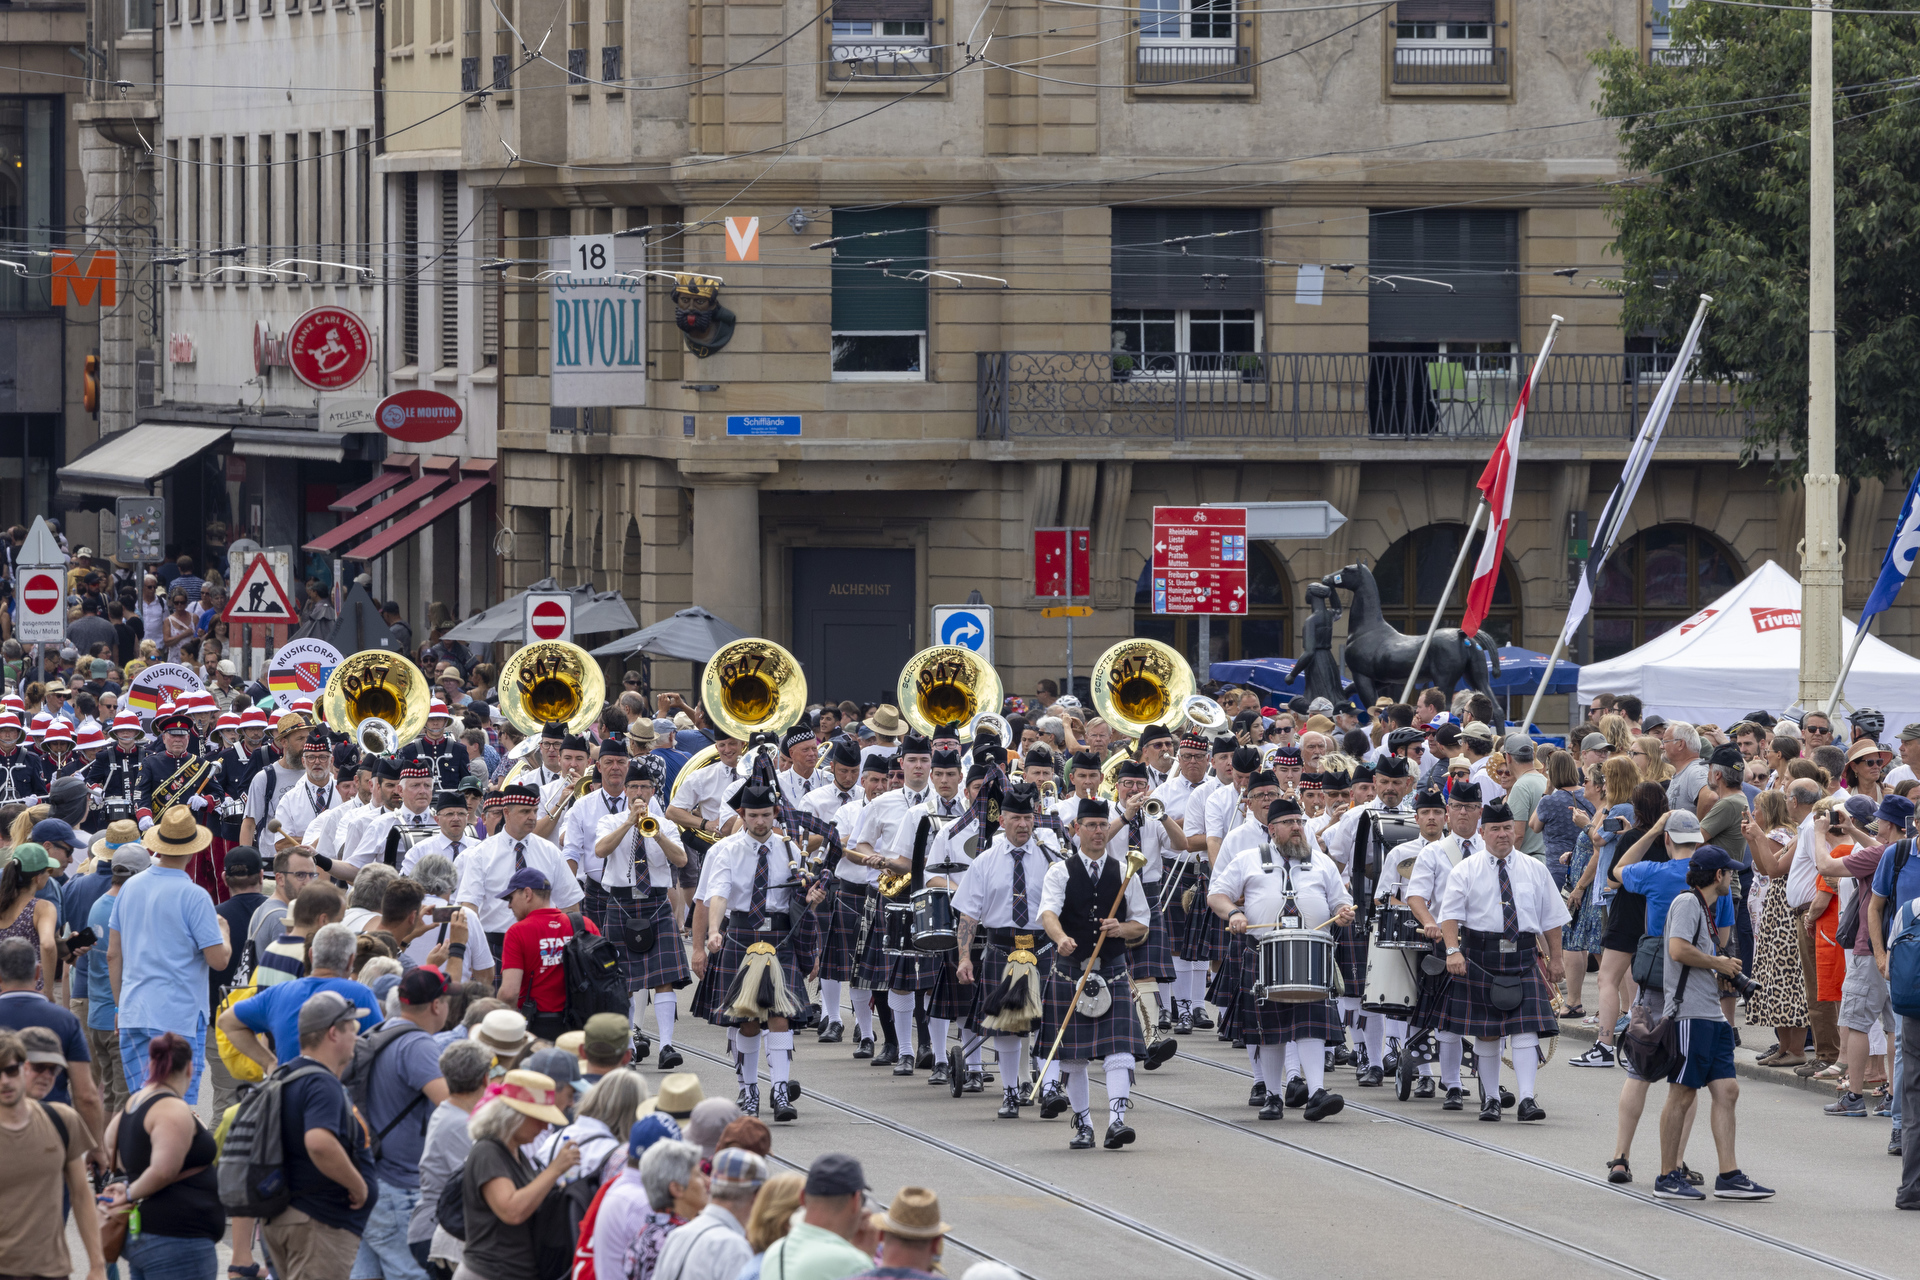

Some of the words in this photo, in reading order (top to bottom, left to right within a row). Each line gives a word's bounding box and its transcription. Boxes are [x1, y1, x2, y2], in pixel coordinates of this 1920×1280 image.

[579, 244, 606, 270] 18
[51, 249, 116, 306] M
[294, 322, 315, 354] FRANZ
[315, 315, 341, 325] CARL
[343, 318, 362, 351] WEBER
[556, 298, 641, 367] RIVOLI
[329, 410, 364, 423] ATELIER
[405, 407, 415, 418] LE
[417, 407, 456, 418] MOUTON
[743, 417, 785, 426] Schifflände
[1168, 528, 1198, 536] Rheinfelden
[1236, 535, 1244, 546] 3
[1168, 544, 1183, 552] Augst
[1236, 551, 1244, 561] 2
[1168, 571, 1189, 580] Freiburg
[828, 583, 891, 595] ALCHEMIST
[1158, 591, 1165, 601] 7
[1168, 587, 1192, 595] Huningue
[1168, 595, 1196, 603] Saint-Louis
[1168, 603, 1193, 612] Binningen
[277, 644, 338, 667] MUSIKCORPS
[502, 653, 526, 692] SCHOTTE
[526, 643, 560, 656] CLIQUE
[719, 654, 766, 691] 1947
[902, 654, 929, 689] SCHOTTE
[929, 648, 964, 658] CLIQUE
[1094, 654, 1114, 694] SCHOTTE
[1113, 642, 1146, 656] CLIQUE
[143, 667, 200, 693] MUSIKCORP
[516, 655, 561, 696] 1947
[915, 661, 963, 699] 1947
[1106, 655, 1148, 696] 1947
[342, 666, 390, 702] 1947
[539, 936, 573, 950] STAF
[541, 952, 564, 966] Tat
